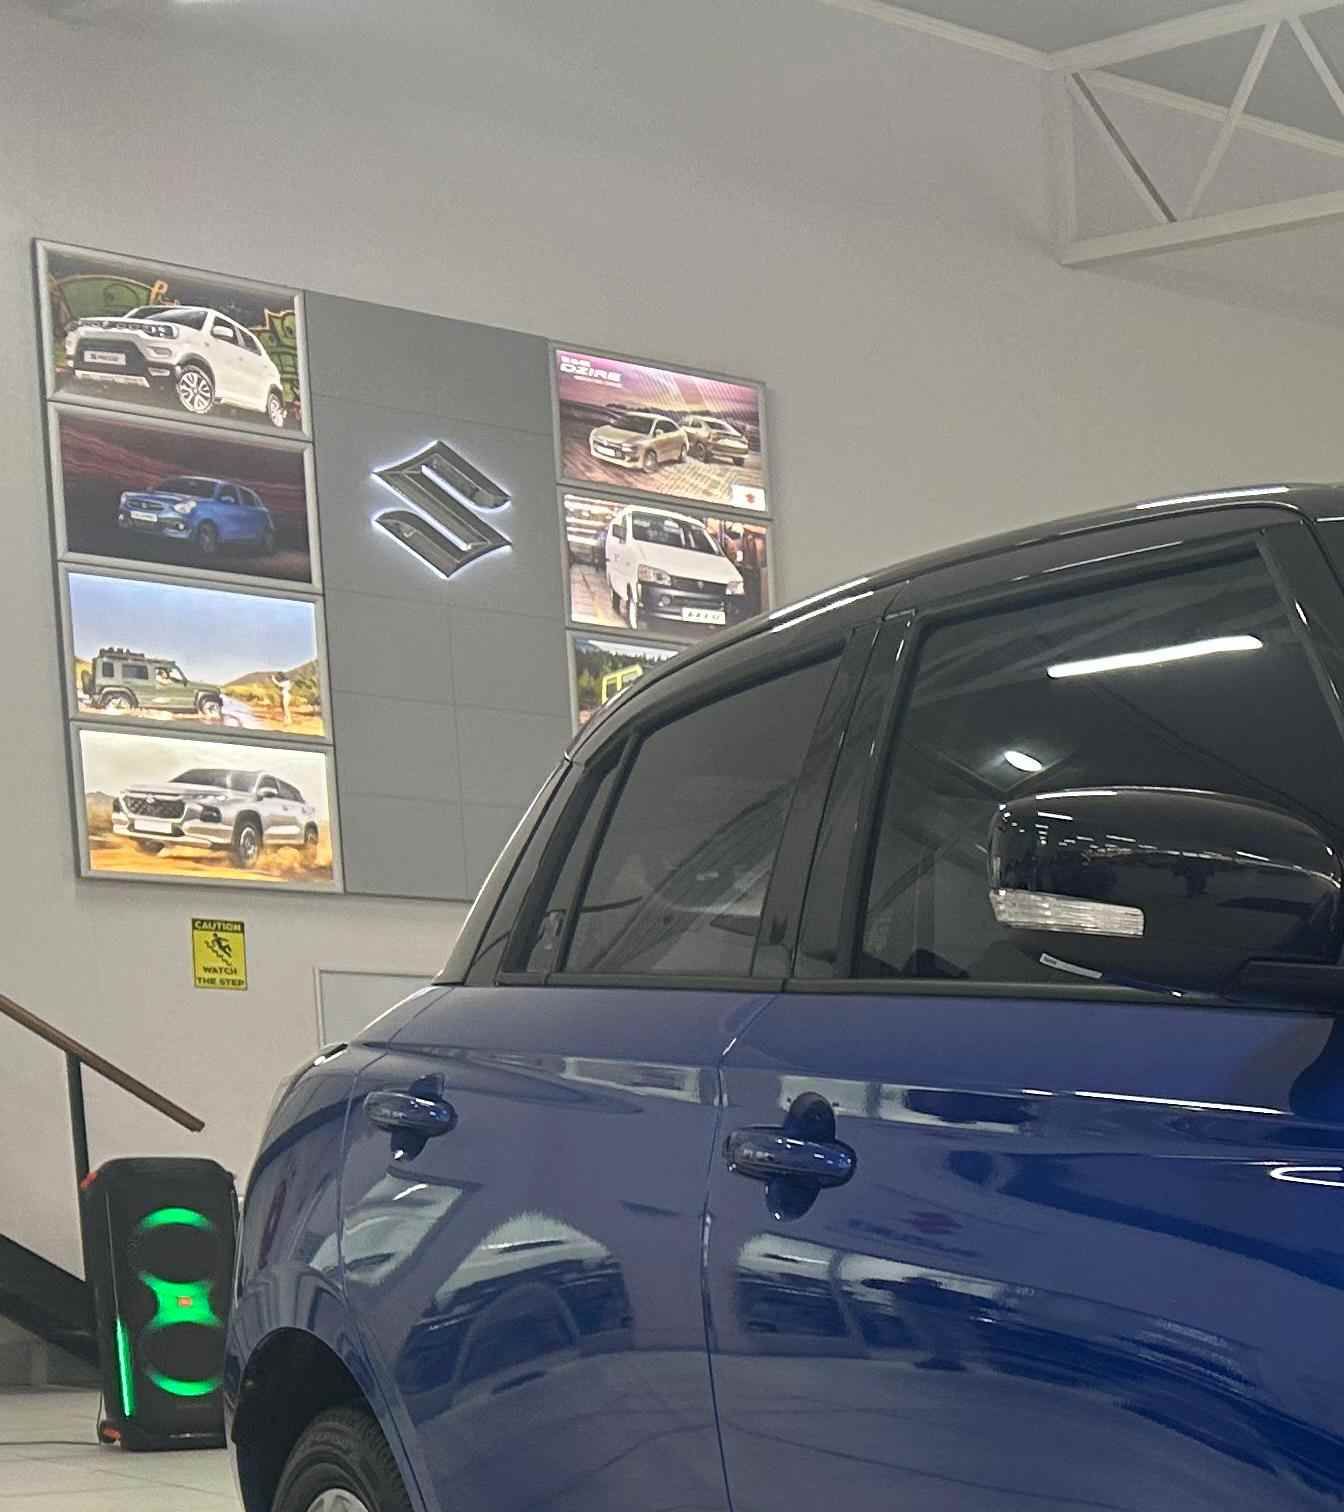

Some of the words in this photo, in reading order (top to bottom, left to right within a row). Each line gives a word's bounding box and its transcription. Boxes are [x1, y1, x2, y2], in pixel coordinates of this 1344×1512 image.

[194, 920, 241, 931] CAUTION
[203, 966, 238, 975] WATCH
[197, 977, 217, 985] THE
[219, 978, 245, 986] STEP
